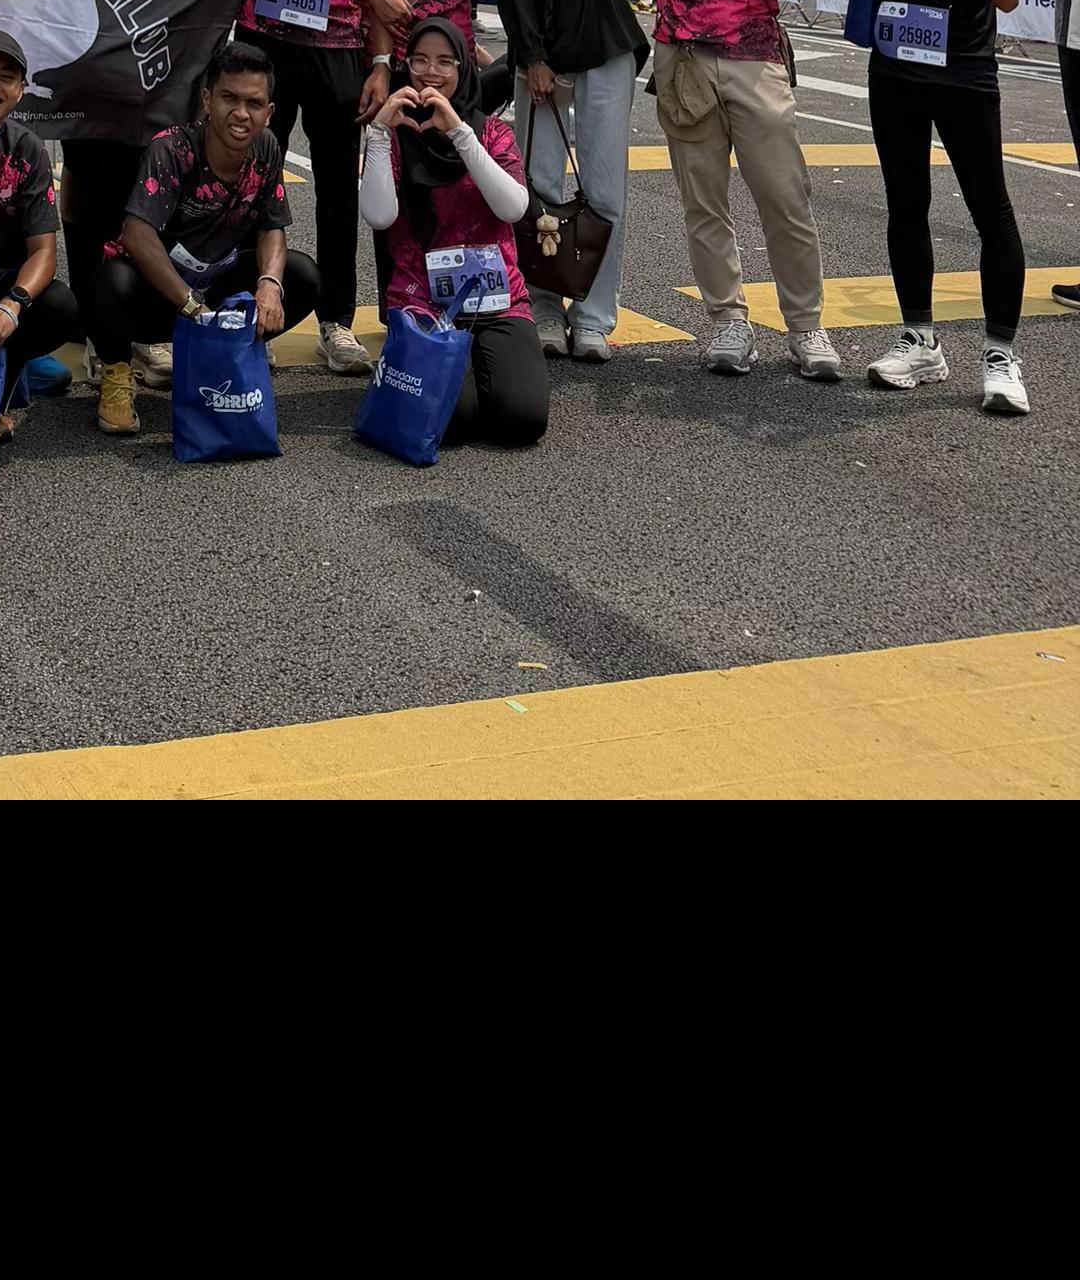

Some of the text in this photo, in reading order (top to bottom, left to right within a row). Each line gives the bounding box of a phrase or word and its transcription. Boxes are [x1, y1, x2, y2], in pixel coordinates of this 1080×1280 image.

[882, 26, 889, 39] 5
[898, 25, 941, 48] 25982
[441, 281, 449, 296] 5
[384, 375, 423, 397] chartered
[387, 365, 423, 387] standard
